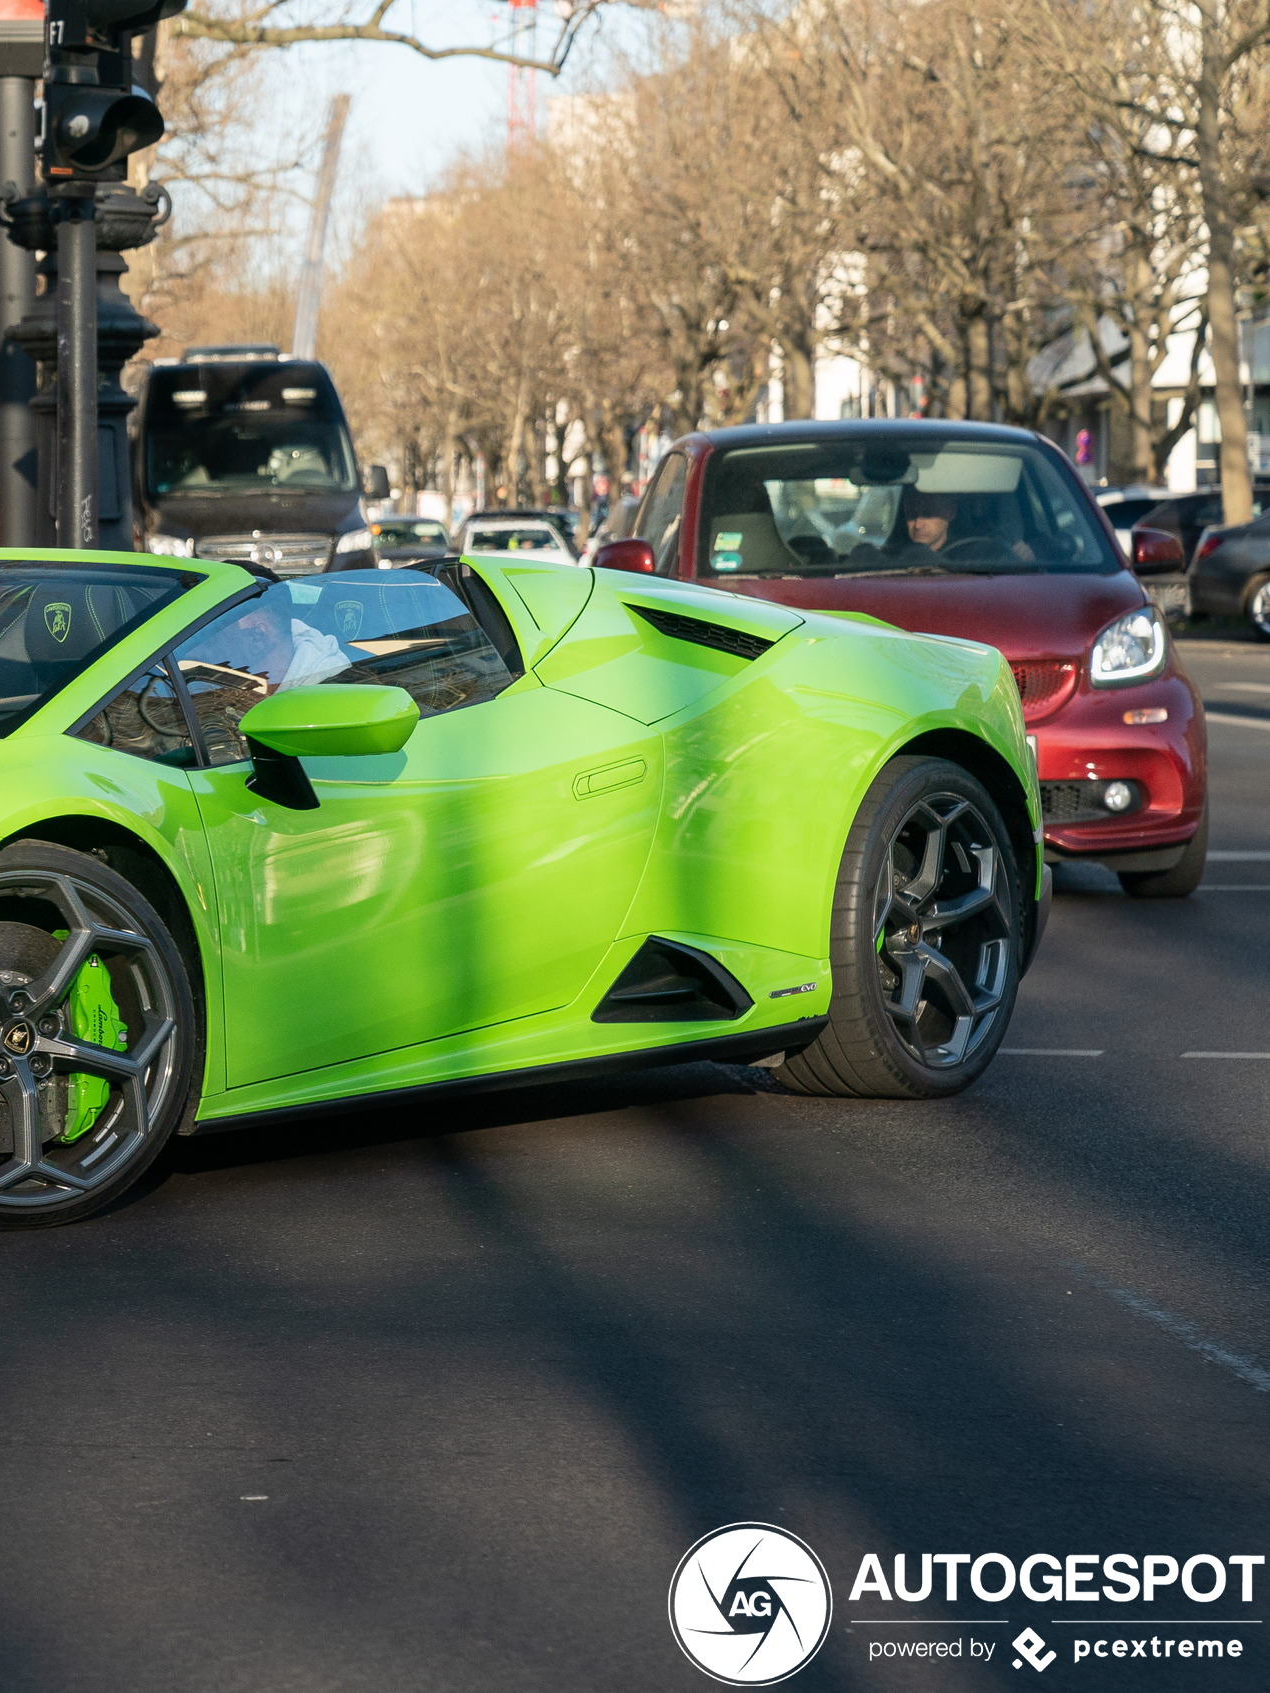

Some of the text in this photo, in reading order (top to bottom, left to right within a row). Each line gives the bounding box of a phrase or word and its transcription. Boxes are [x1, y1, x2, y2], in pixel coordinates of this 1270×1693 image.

[50, 20, 65, 46] F7
[800, 983, 817, 992] EVO
[98, 1004, 108, 1045] Lambor
